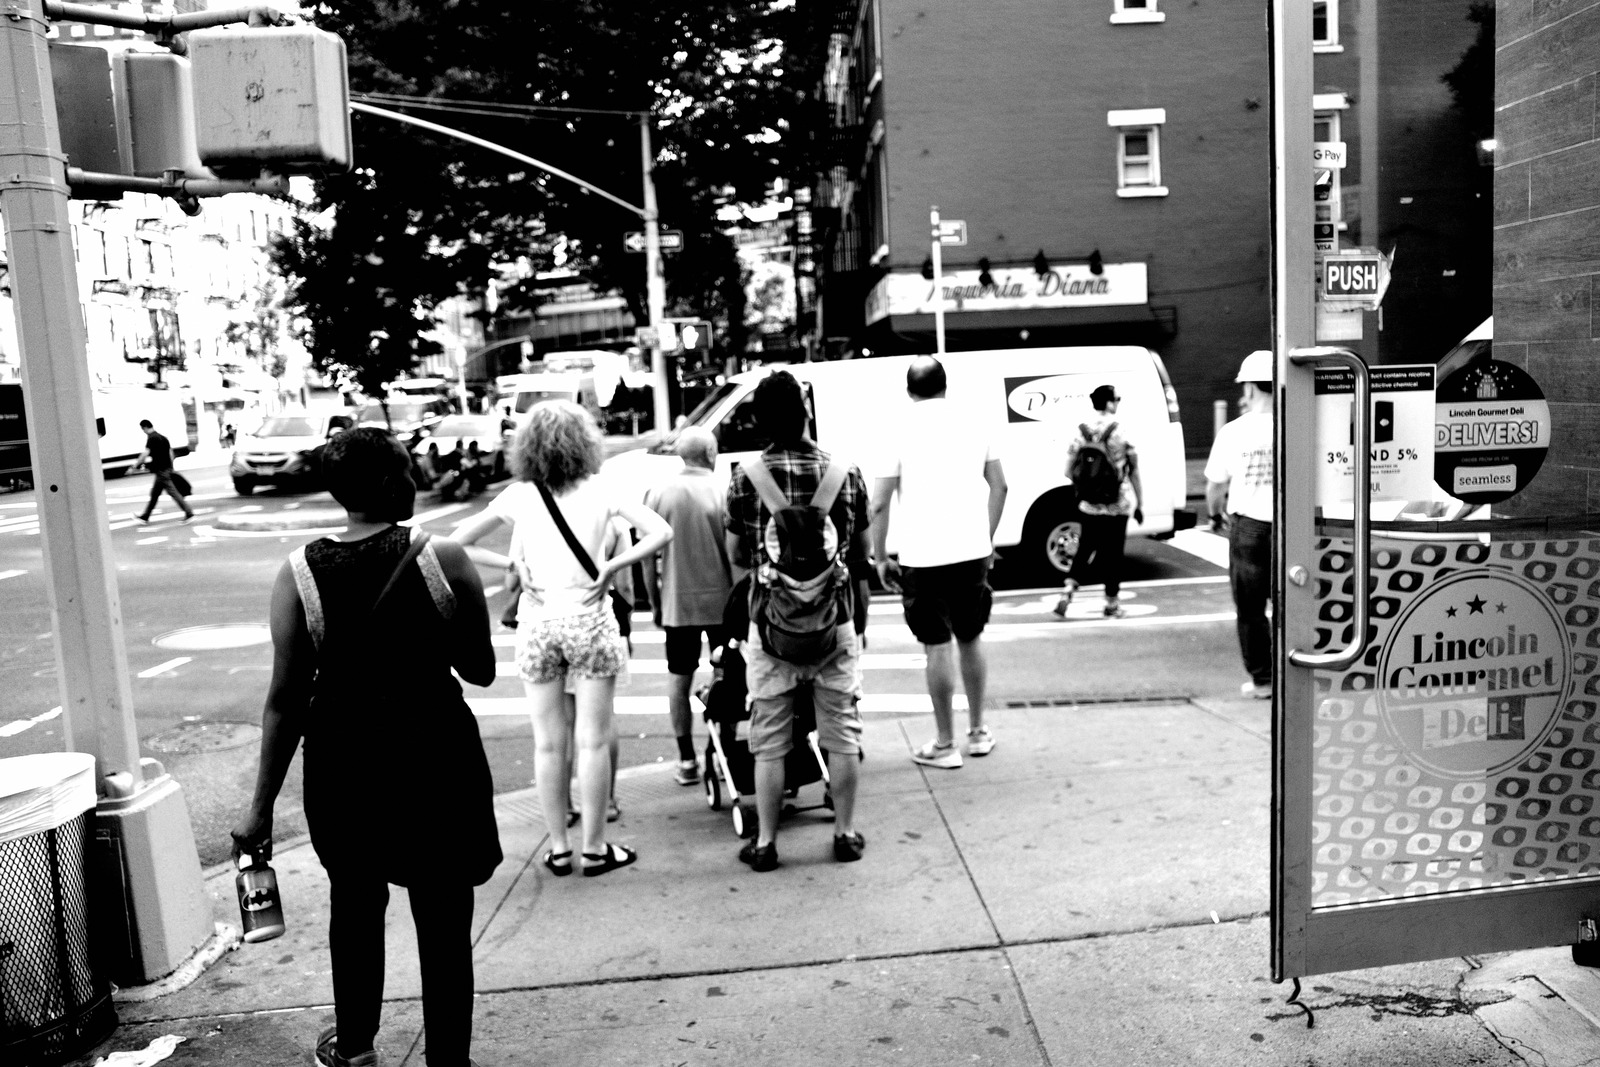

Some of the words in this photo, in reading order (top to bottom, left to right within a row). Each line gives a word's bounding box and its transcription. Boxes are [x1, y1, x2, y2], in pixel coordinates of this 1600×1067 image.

[1313, 149, 1322, 160] G
[1325, 149, 1341, 161] Pay
[927, 276, 1026, 309] aqueria
[1037, 270, 1109, 297] Diana
[1328, 265, 1377, 291] PUSH
[1449, 408, 1476, 418] Lincoln
[1477, 407, 1509, 417] Gourmet
[1510, 407, 1525, 416] Deli
[1435, 420, 1539, 448] DELIVERS!
[1327, 451, 1349, 464] 3%
[1370, 449, 1390, 461] ND
[1397, 448, 1418, 460] 5%
[1459, 474, 1512, 486] seamless
[1412, 624, 1539, 665] Lincoln
[1389, 656, 1560, 699] Gourmet
